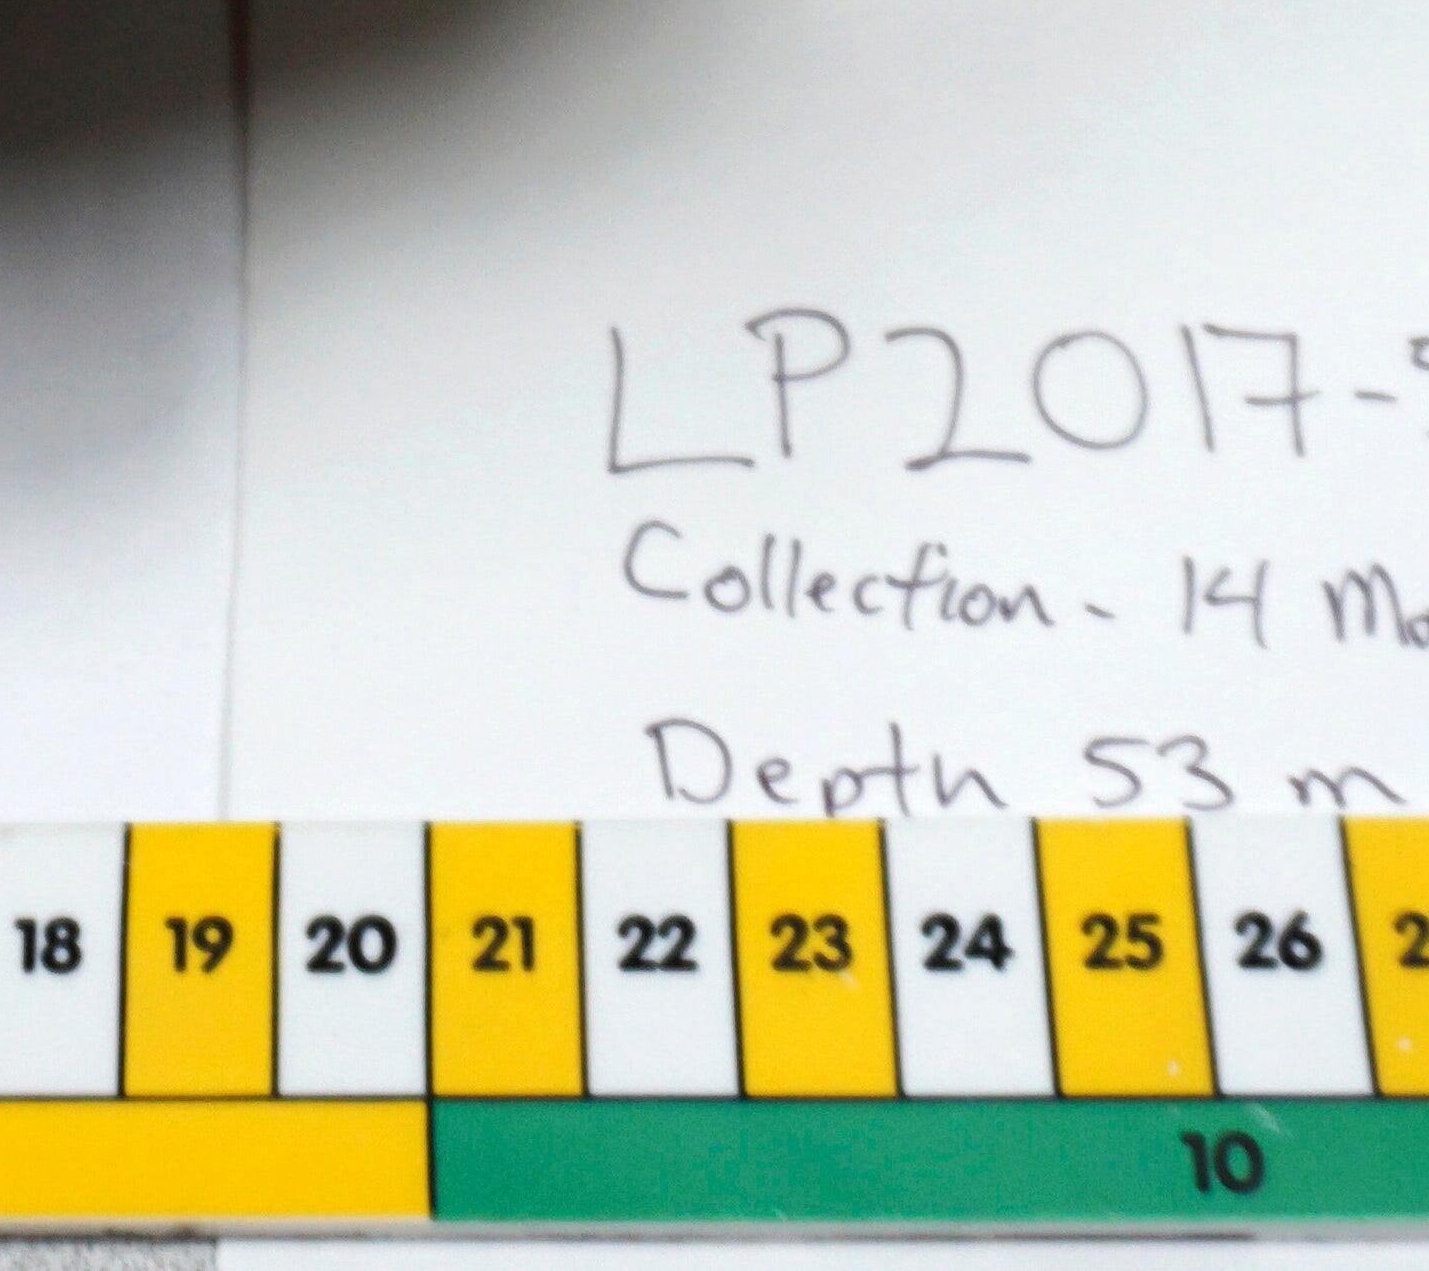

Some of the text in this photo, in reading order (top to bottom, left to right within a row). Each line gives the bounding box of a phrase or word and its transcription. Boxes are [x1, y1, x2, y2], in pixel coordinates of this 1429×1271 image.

[621, 518, 1055, 631] Collection
[1180, 554, 1270, 649] 14
[644, 716, 1408, 819] Depth 53 m
[15, 916, 82, 975] 18
[165, 916, 234, 973] 19
[306, 914, 398, 975] 20
[472, 916, 535, 972] 21
[617, 914, 698, 972] 22
[770, 914, 853, 973] 23
[921, 913, 1013, 972] 24
[1082, 913, 1164, 971] 25
[1234, 911, 1323, 971] 26
[1182, 1129, 1267, 1197] 10
